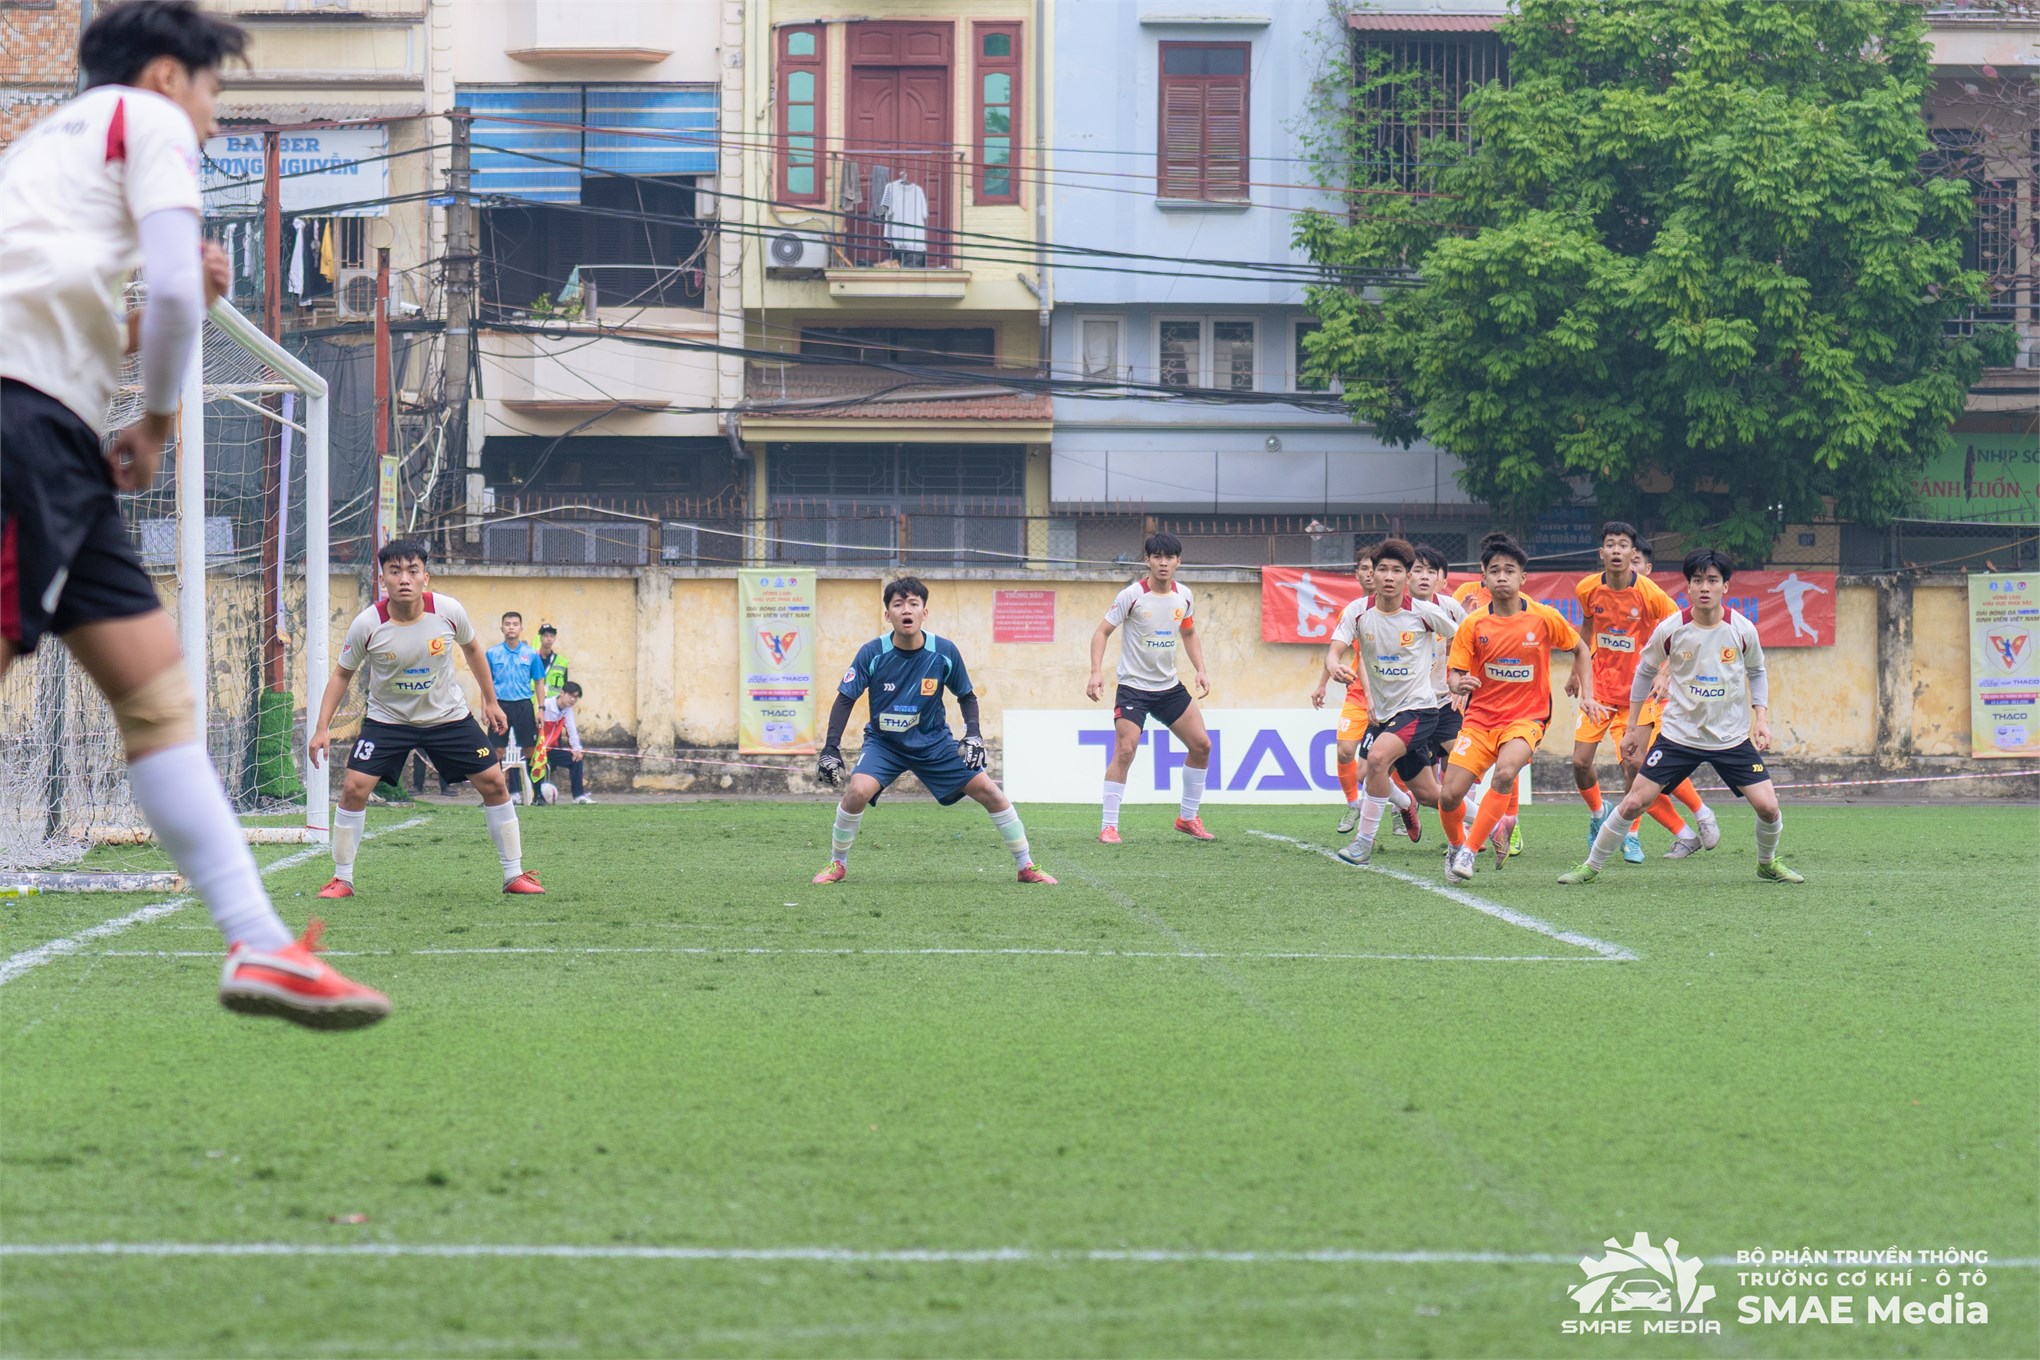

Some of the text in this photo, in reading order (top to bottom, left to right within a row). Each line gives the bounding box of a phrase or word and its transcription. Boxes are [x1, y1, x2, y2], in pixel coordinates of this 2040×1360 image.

[226, 137, 320, 152] BABER
[1146, 640, 1175, 648] THACO
[1374, 665, 1409, 676] THACO
[1488, 667, 1530, 678] THACO
[1689, 685, 1725, 697] THACO
[353, 739, 375, 761] 13
[1453, 735, 1472, 757] 12
[1078, 729, 1362, 791] THA
[1646, 750, 1663, 767] 8
